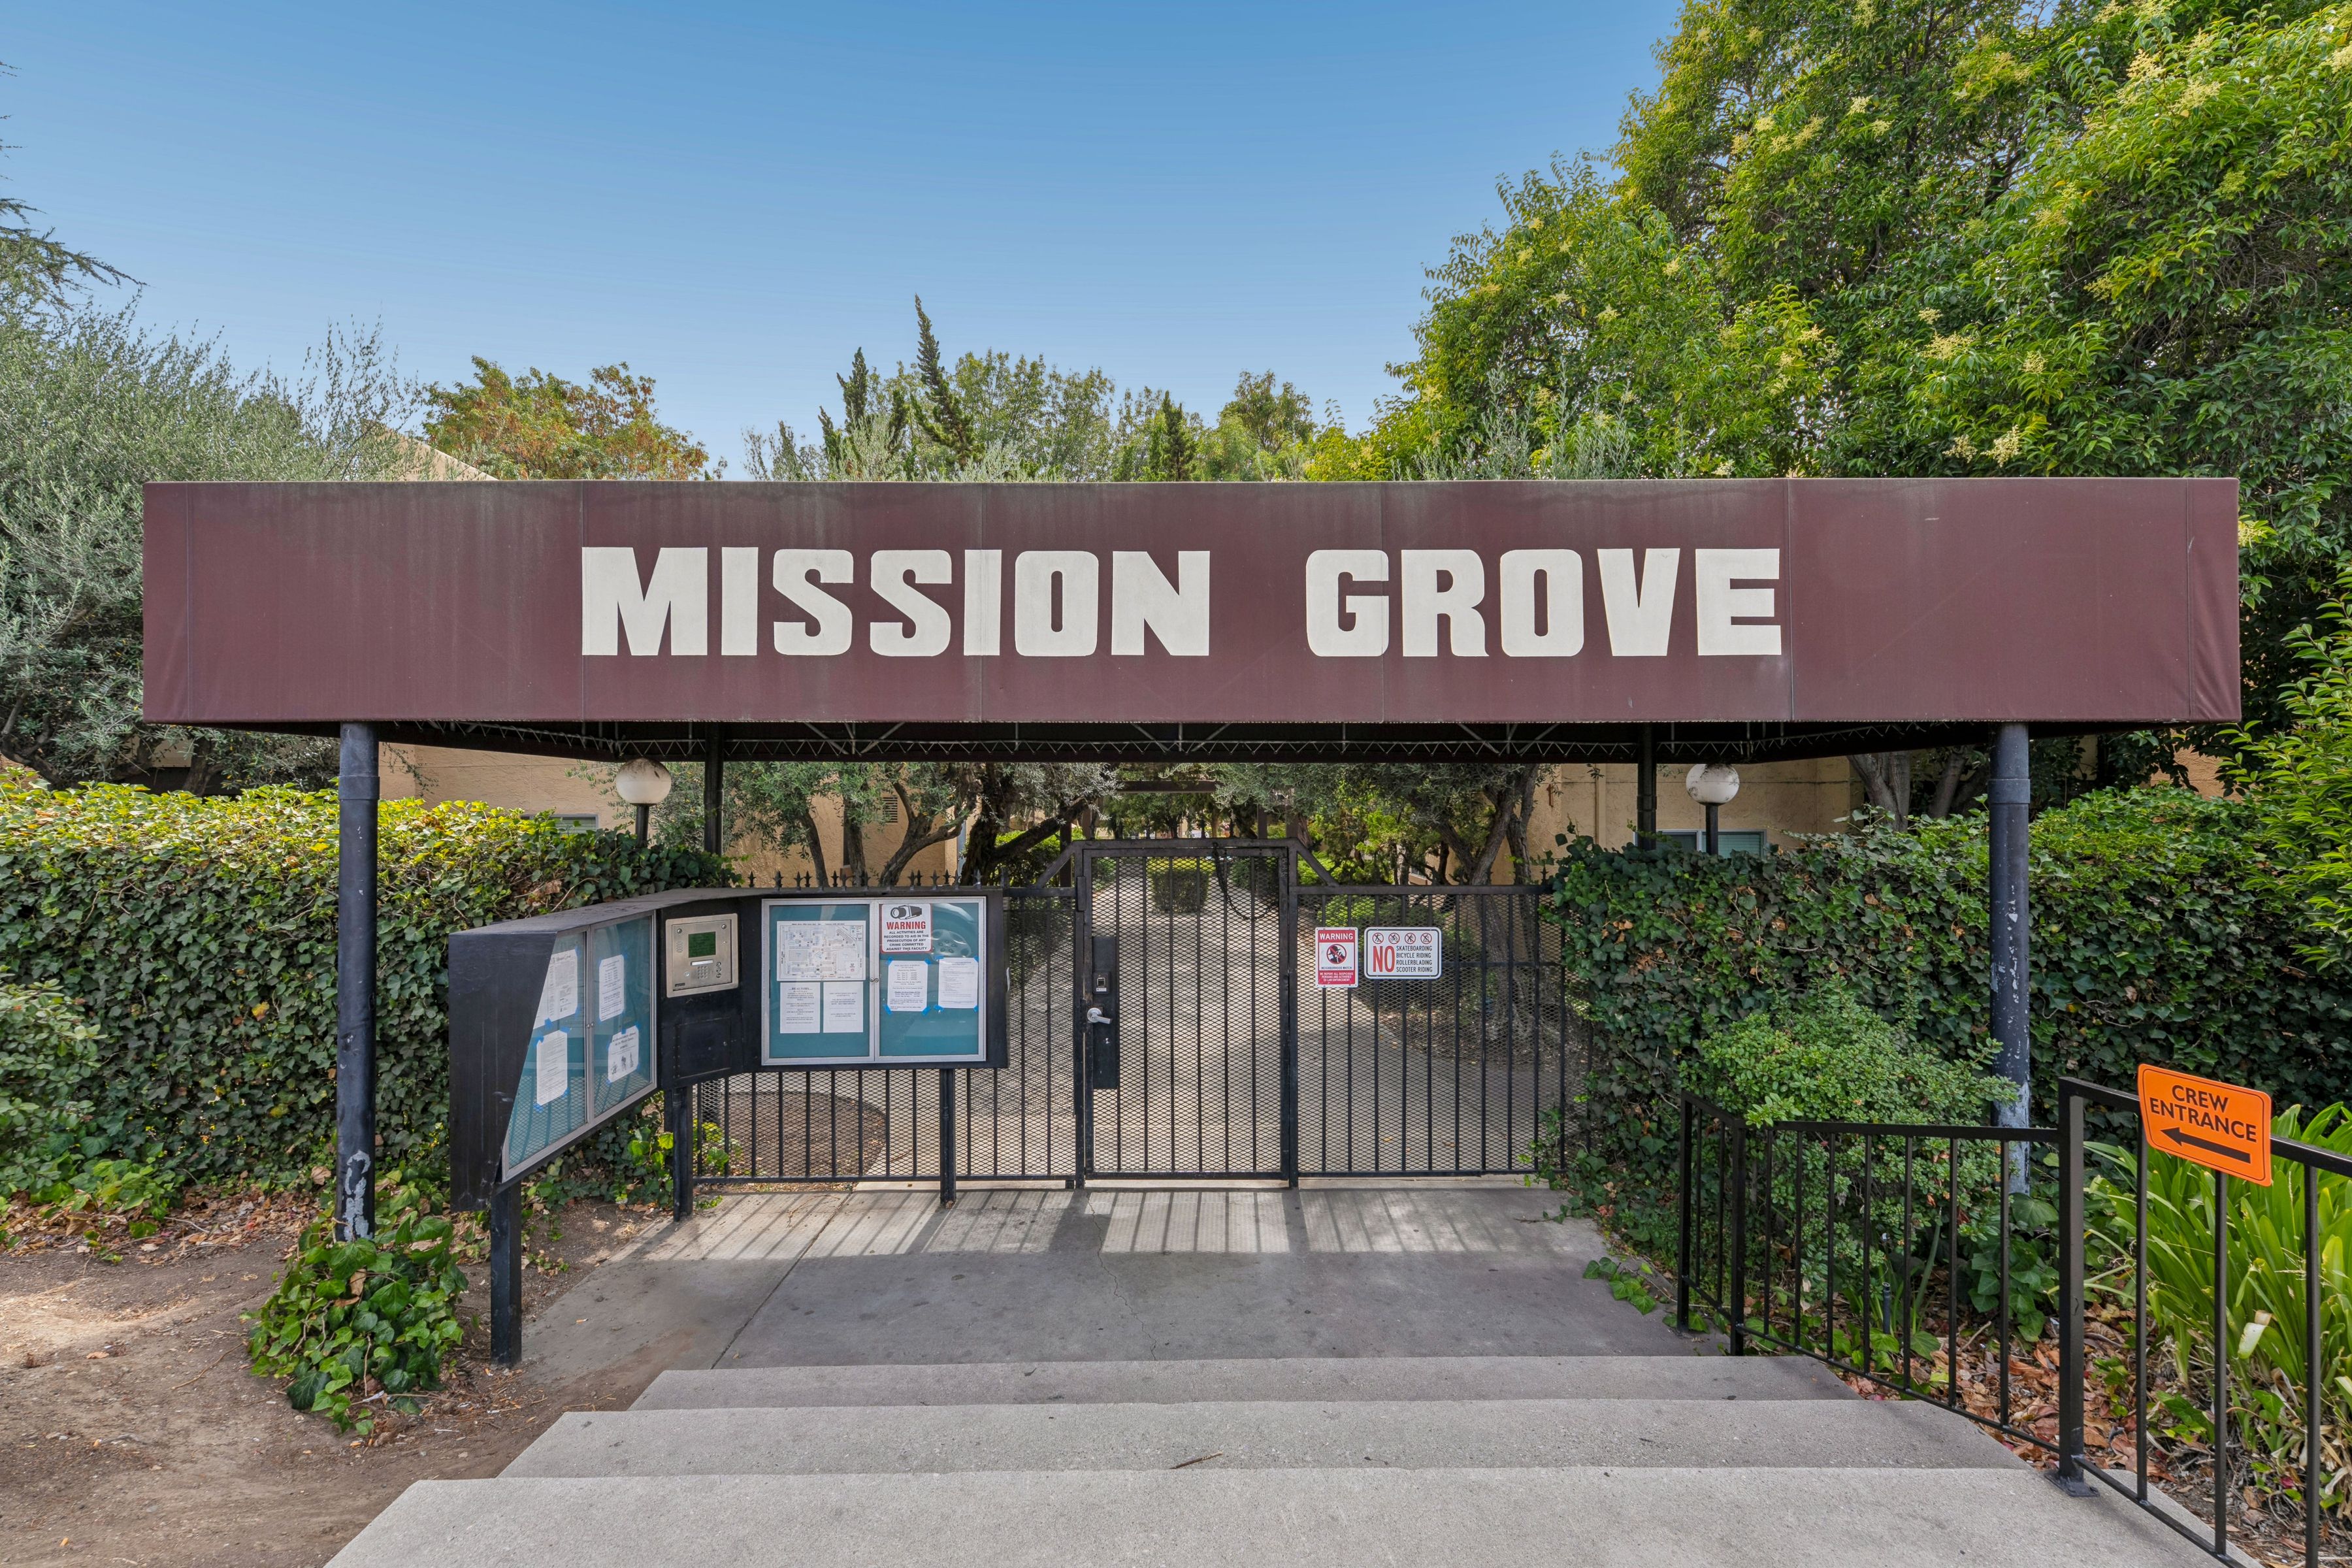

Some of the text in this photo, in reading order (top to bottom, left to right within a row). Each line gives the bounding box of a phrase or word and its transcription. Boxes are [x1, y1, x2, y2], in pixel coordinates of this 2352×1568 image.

[581, 547, 1782, 657] MISSION GROVE
[887, 921, 926, 930] WARNING
[1373, 945, 1396, 972] NO
[2172, 1085, 2229, 1113] CREW
[2149, 1097, 2257, 1143] ENTRANCE
